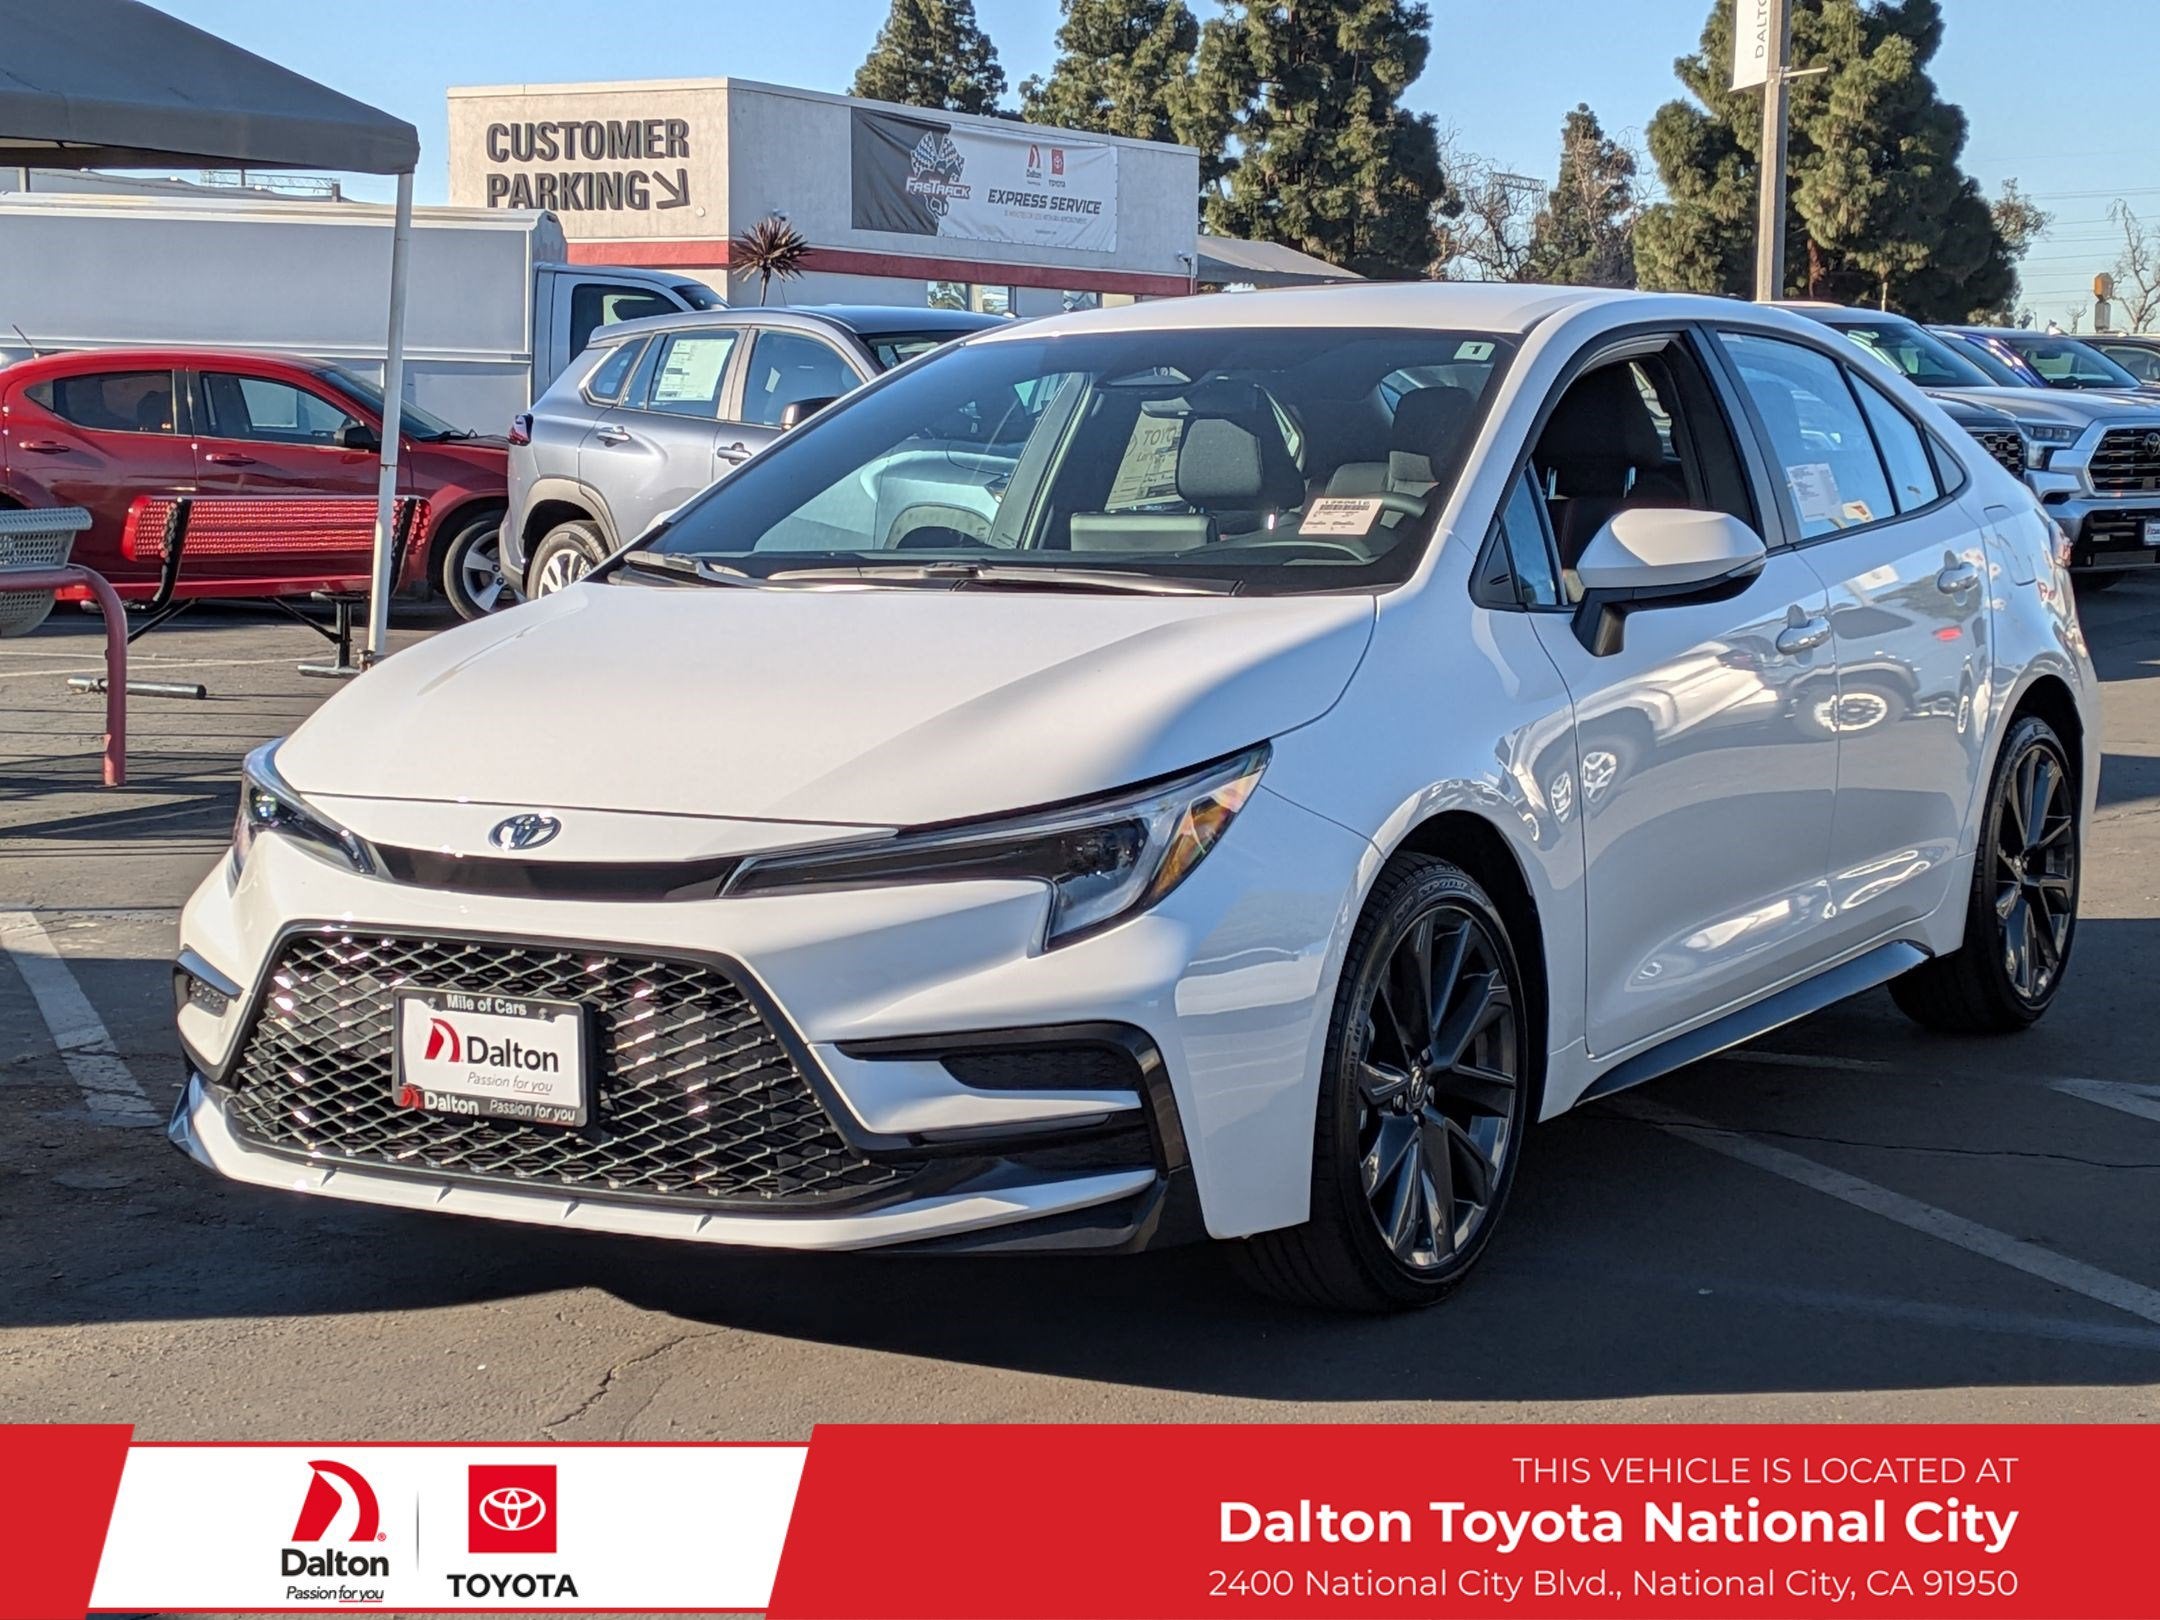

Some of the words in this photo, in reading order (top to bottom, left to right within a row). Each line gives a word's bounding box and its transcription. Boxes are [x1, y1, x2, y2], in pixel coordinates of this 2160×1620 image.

[486, 118, 690, 163] CUSTOMER
[486, 170, 651, 211] PARKING
[987, 188, 1048, 209] EXPRESS
[1049, 195, 1102, 215] SERVICE
[446, 994, 475, 1011] Mile
[477, 998, 493, 1012] of
[494, 1000, 527, 1016] Cars
[466, 1036, 559, 1073] Dalton
[467, 1071, 510, 1088] Passion
[512, 1075, 529, 1090] for
[530, 1082, 554, 1095] you
[424, 1091, 480, 1116] Dalton
[489, 1099, 532, 1117] Passion
[534, 1104, 551, 1119] for
[553, 1107, 576, 1122] you
